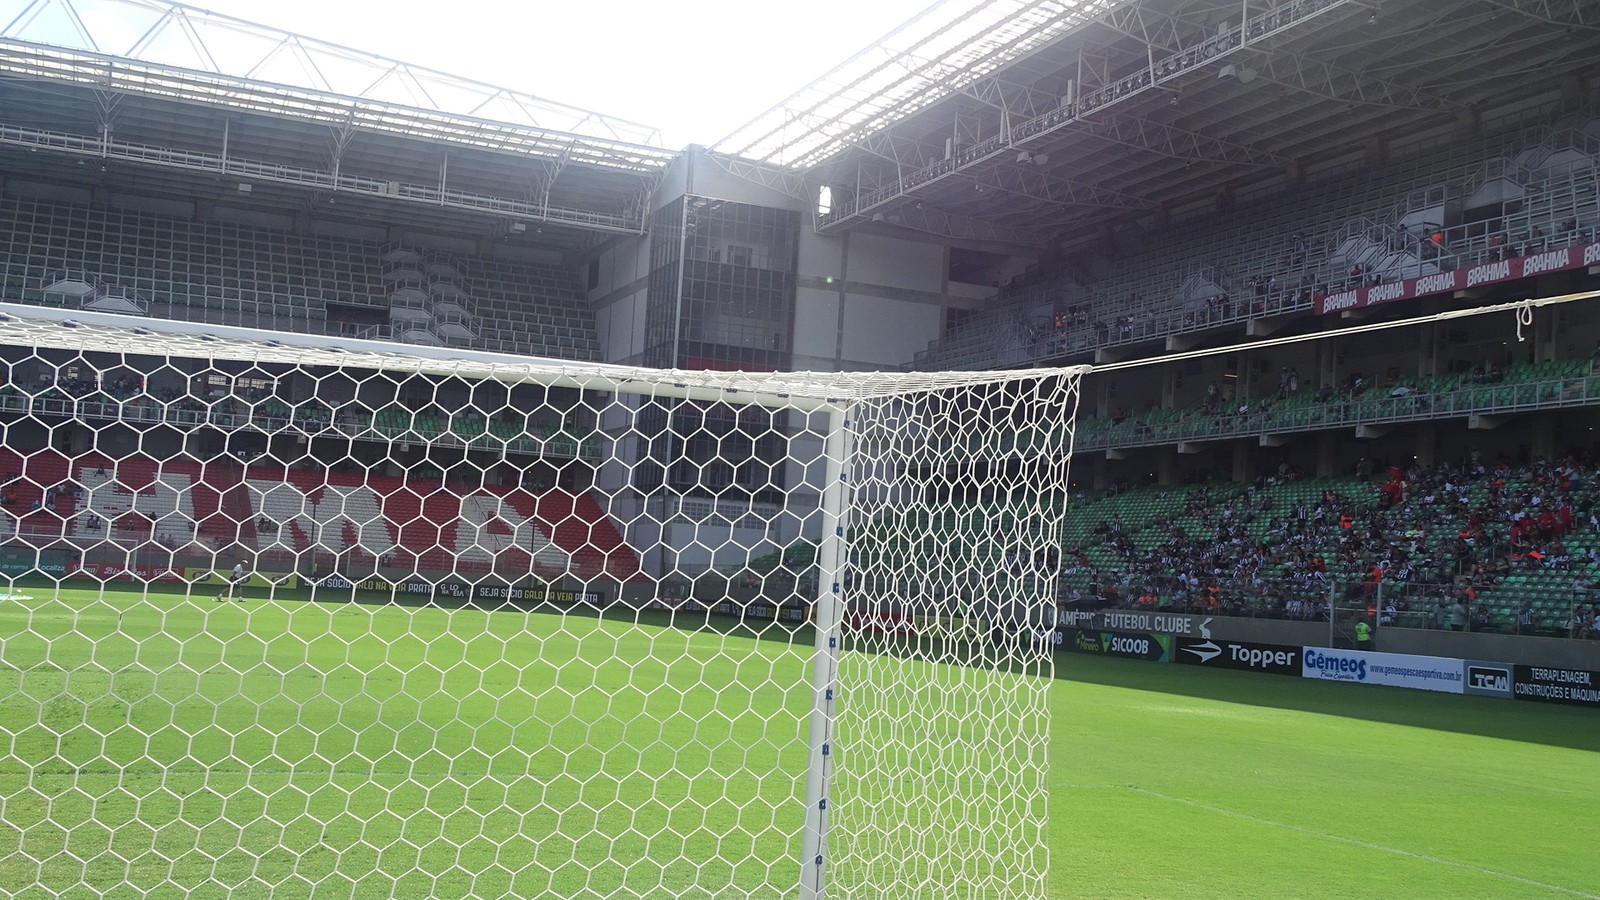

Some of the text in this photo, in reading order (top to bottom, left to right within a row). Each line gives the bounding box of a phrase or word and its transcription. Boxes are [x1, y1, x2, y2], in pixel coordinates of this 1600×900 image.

[1467, 260, 1510, 287] BRAHMA
[1523, 248, 1570, 277] BRAHMA
[1367, 281, 1404, 305] BRAHMA
[1415, 271, 1455, 296] BRAHMA
[1323, 290, 1357, 313] BRAHMA
[375, 581, 387, 591] NA
[408, 583, 435, 594] PRATA
[480, 587, 499, 597] SEJA
[500, 588, 522, 600] SÓCIO
[524, 591, 544, 600] GALO
[556, 592, 574, 602] VEIA
[575, 593, 598, 603] PRATA
[1104, 612, 1152, 631] FUTEBOL
[1154, 616, 1192, 634] CLUBE
[1111, 637, 1149, 655] SICOOB
[1228, 644, 1296, 669] Topper
[1305, 650, 1366, 680] Gêmeos
[1475, 673, 1509, 691] TCM
[1530, 667, 1592, 686] TERRAPLENAGEM,
[1515, 682, 1563, 700] CONSTRUÇÕES
[1564, 687, 1570, 699] E
